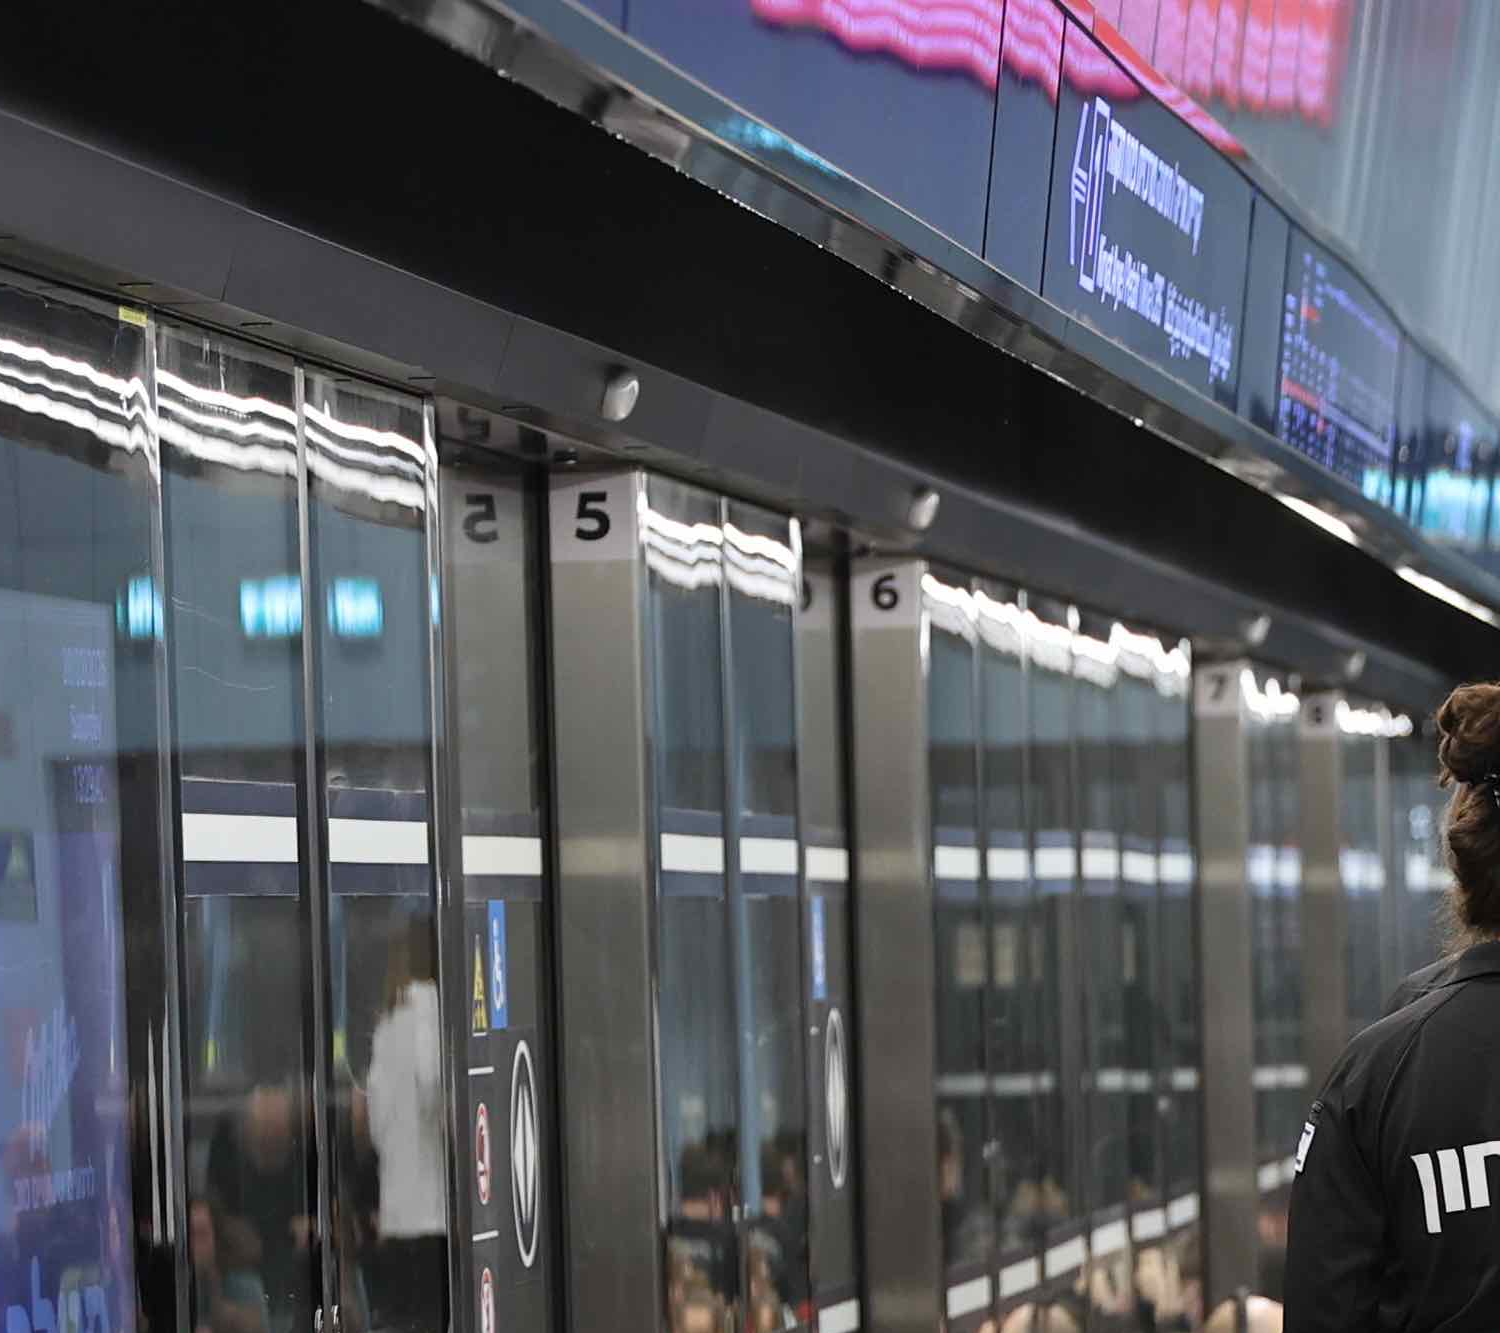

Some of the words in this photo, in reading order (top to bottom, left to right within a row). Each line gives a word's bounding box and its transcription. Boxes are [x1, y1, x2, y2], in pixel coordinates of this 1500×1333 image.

[575, 491, 611, 541] 5
[870, 573, 898, 611] 6
[1209, 674, 1227, 700] 7
